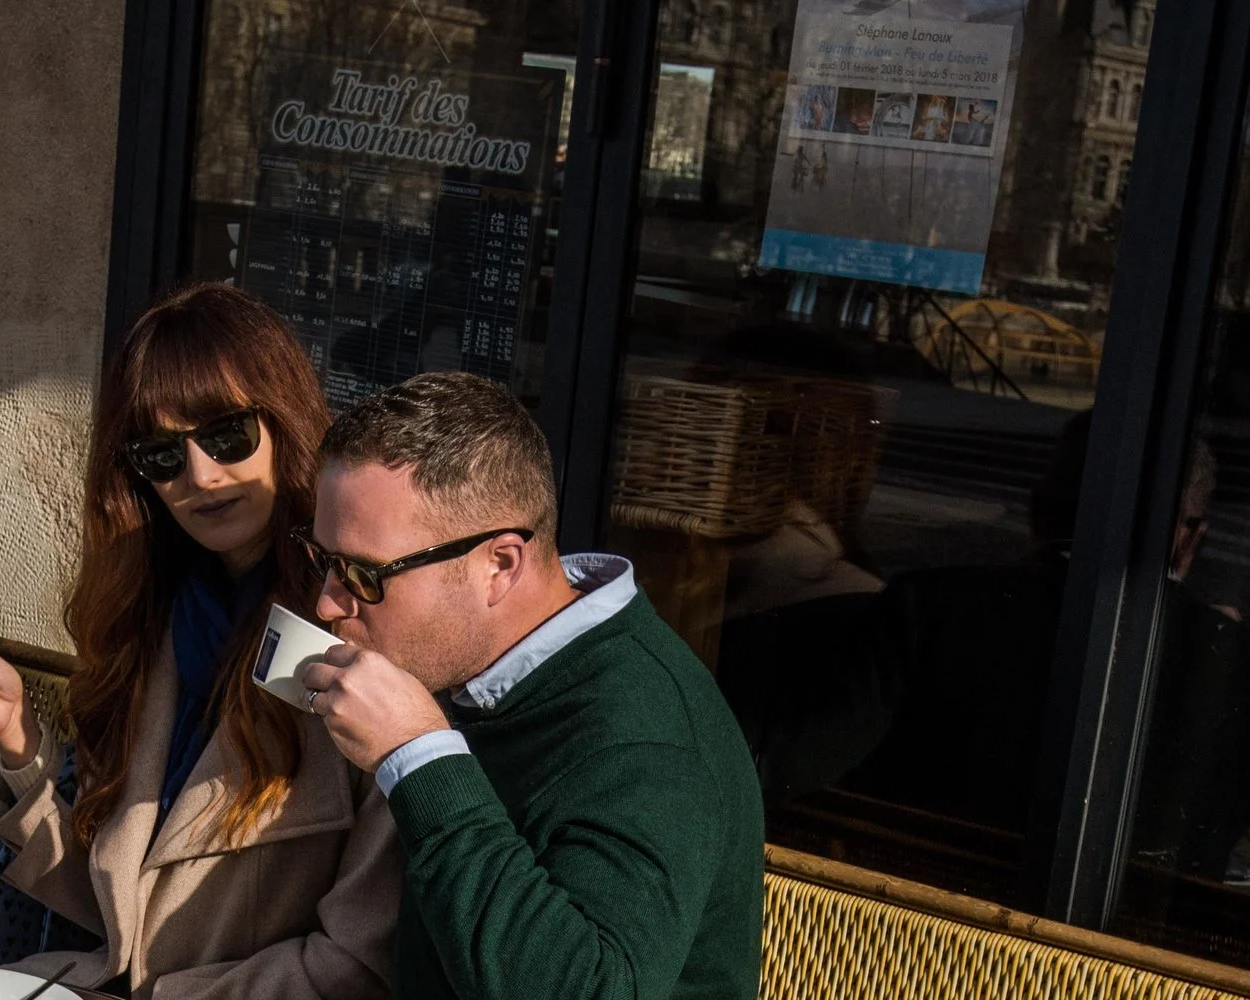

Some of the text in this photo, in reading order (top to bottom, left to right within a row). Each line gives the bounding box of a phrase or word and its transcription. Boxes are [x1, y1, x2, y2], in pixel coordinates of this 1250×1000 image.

[880, 64, 903, 76] 2018
[973, 71, 998, 84] 2018
[929, 47, 944, 62] de
[330, 68, 470, 126] Tarif des
[272, 99, 530, 174] Consommations
